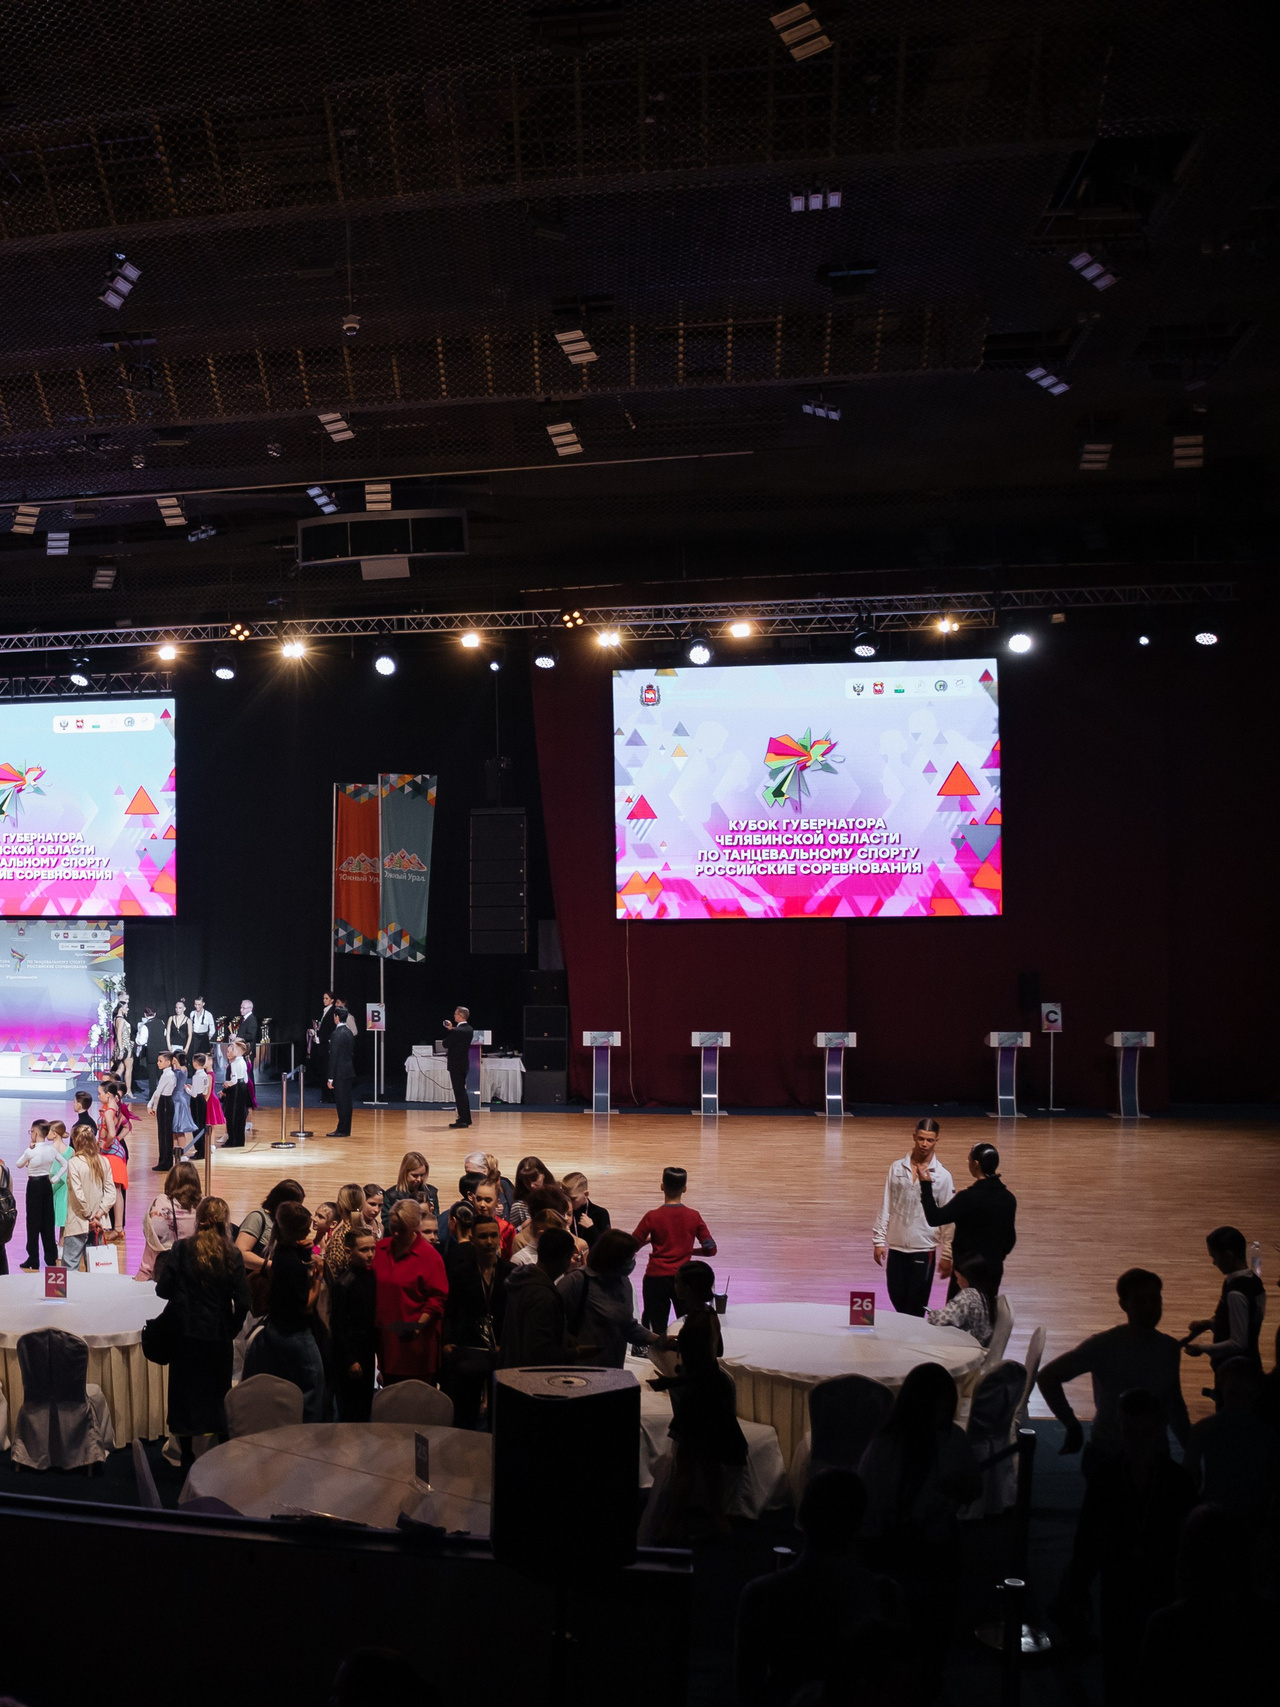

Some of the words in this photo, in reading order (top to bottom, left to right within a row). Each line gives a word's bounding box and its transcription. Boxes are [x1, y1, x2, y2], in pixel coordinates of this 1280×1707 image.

[728, 819, 778, 831] КУБОК
[782, 818, 886, 830] ГУБЕРНАТОРА
[3, 832, 84, 843] ГУБЕРНАТОРА
[715, 830, 824, 846] ЧЕЛЯБИНСКОЙ
[828, 832, 900, 845] ОБЛАСТИ
[38, 844, 96, 856] ОБЛАСТИ
[697, 850, 720, 862] ПО
[723, 848, 853, 864] ТАНЦЕВАЛЬНОМУ
[857, 847, 919, 860] СПОРТУ
[61, 857, 110, 868] СПОРТУ
[695, 861, 796, 876] РОССИЙСКИЕ
[800, 862, 922, 875] СОРЕВНОВАНИЯ
[16, 870, 113, 881] СОРЕВНОВАНИЯ
[369, 875, 380, 884] Ур
[407, 873, 426, 883] Урал
[371, 1010, 381, 1022] B
[1045, 1010, 1059, 1023] C
[47, 1272, 65, 1284] 22
[852, 1297, 872, 1311] 26
